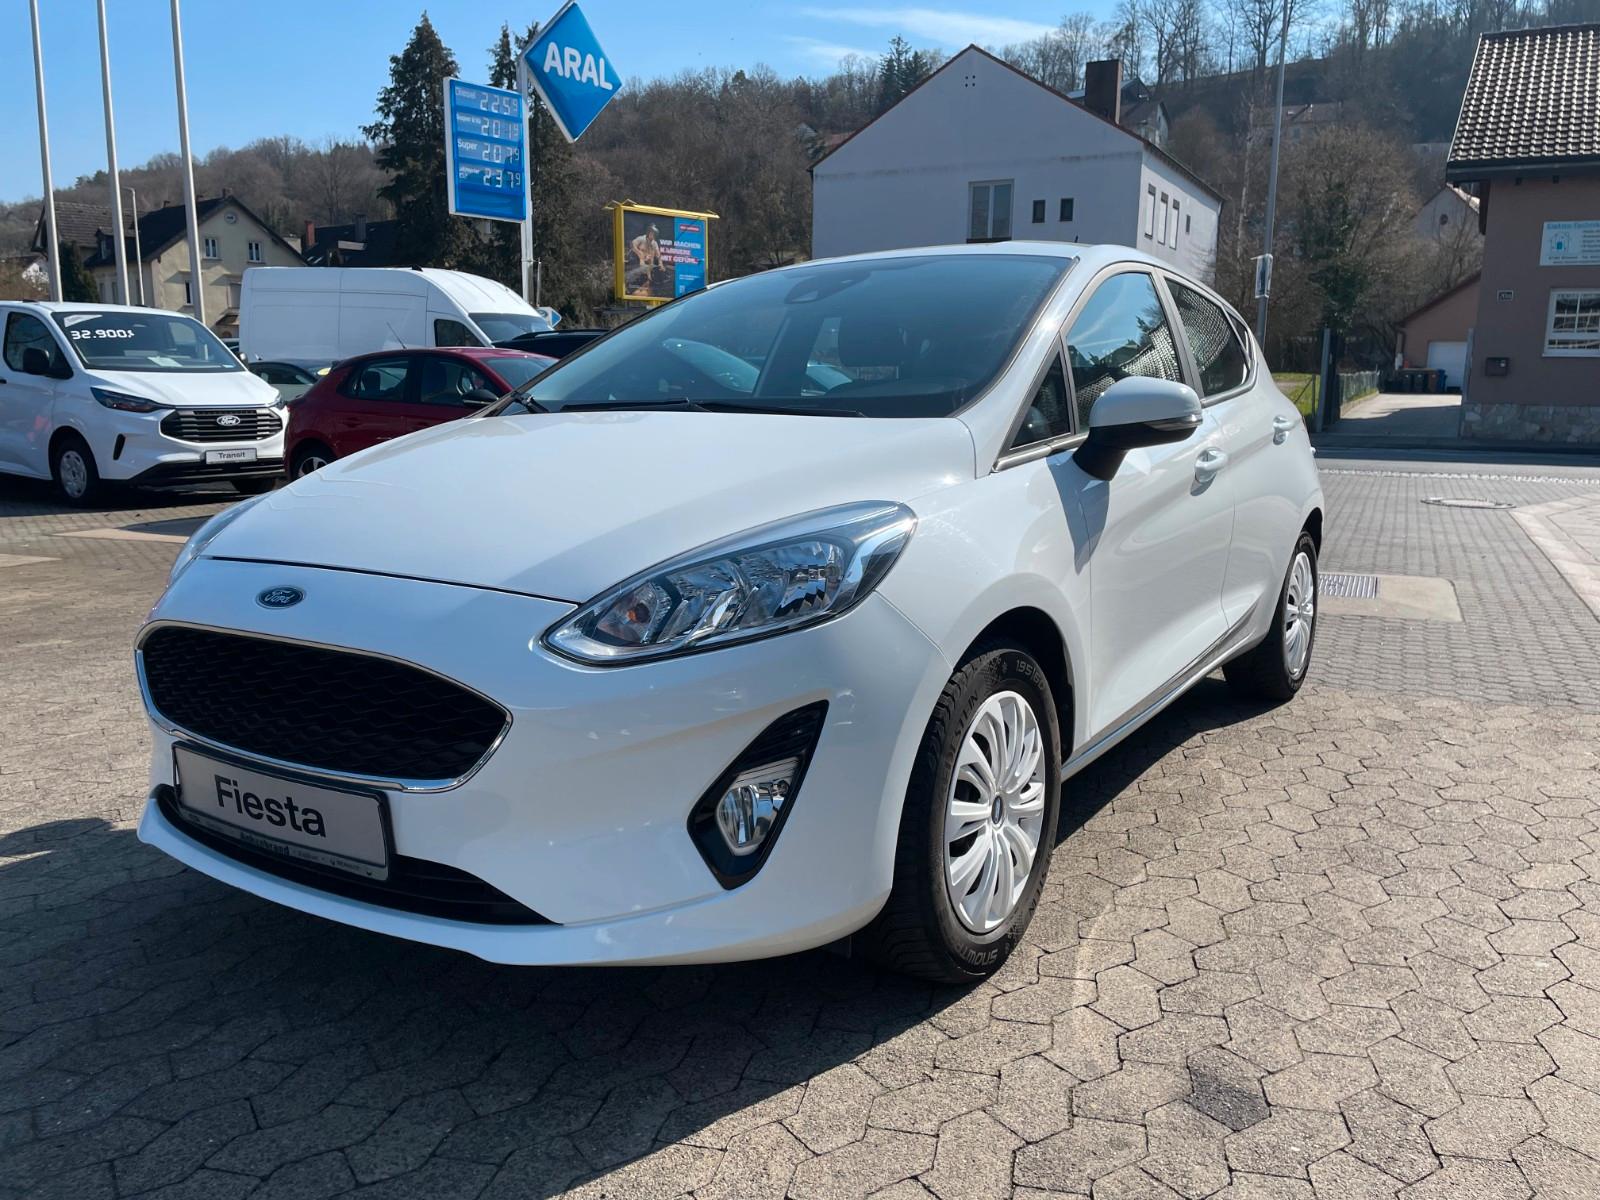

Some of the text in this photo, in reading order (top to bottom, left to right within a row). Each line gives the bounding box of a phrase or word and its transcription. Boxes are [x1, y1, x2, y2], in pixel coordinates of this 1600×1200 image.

[543, 41, 613, 90] ARAL
[457, 138, 478, 151] Super
[217, 451, 246, 459] Transit
[264, 589, 296, 604] Ford
[214, 774, 327, 838] Fiesta
